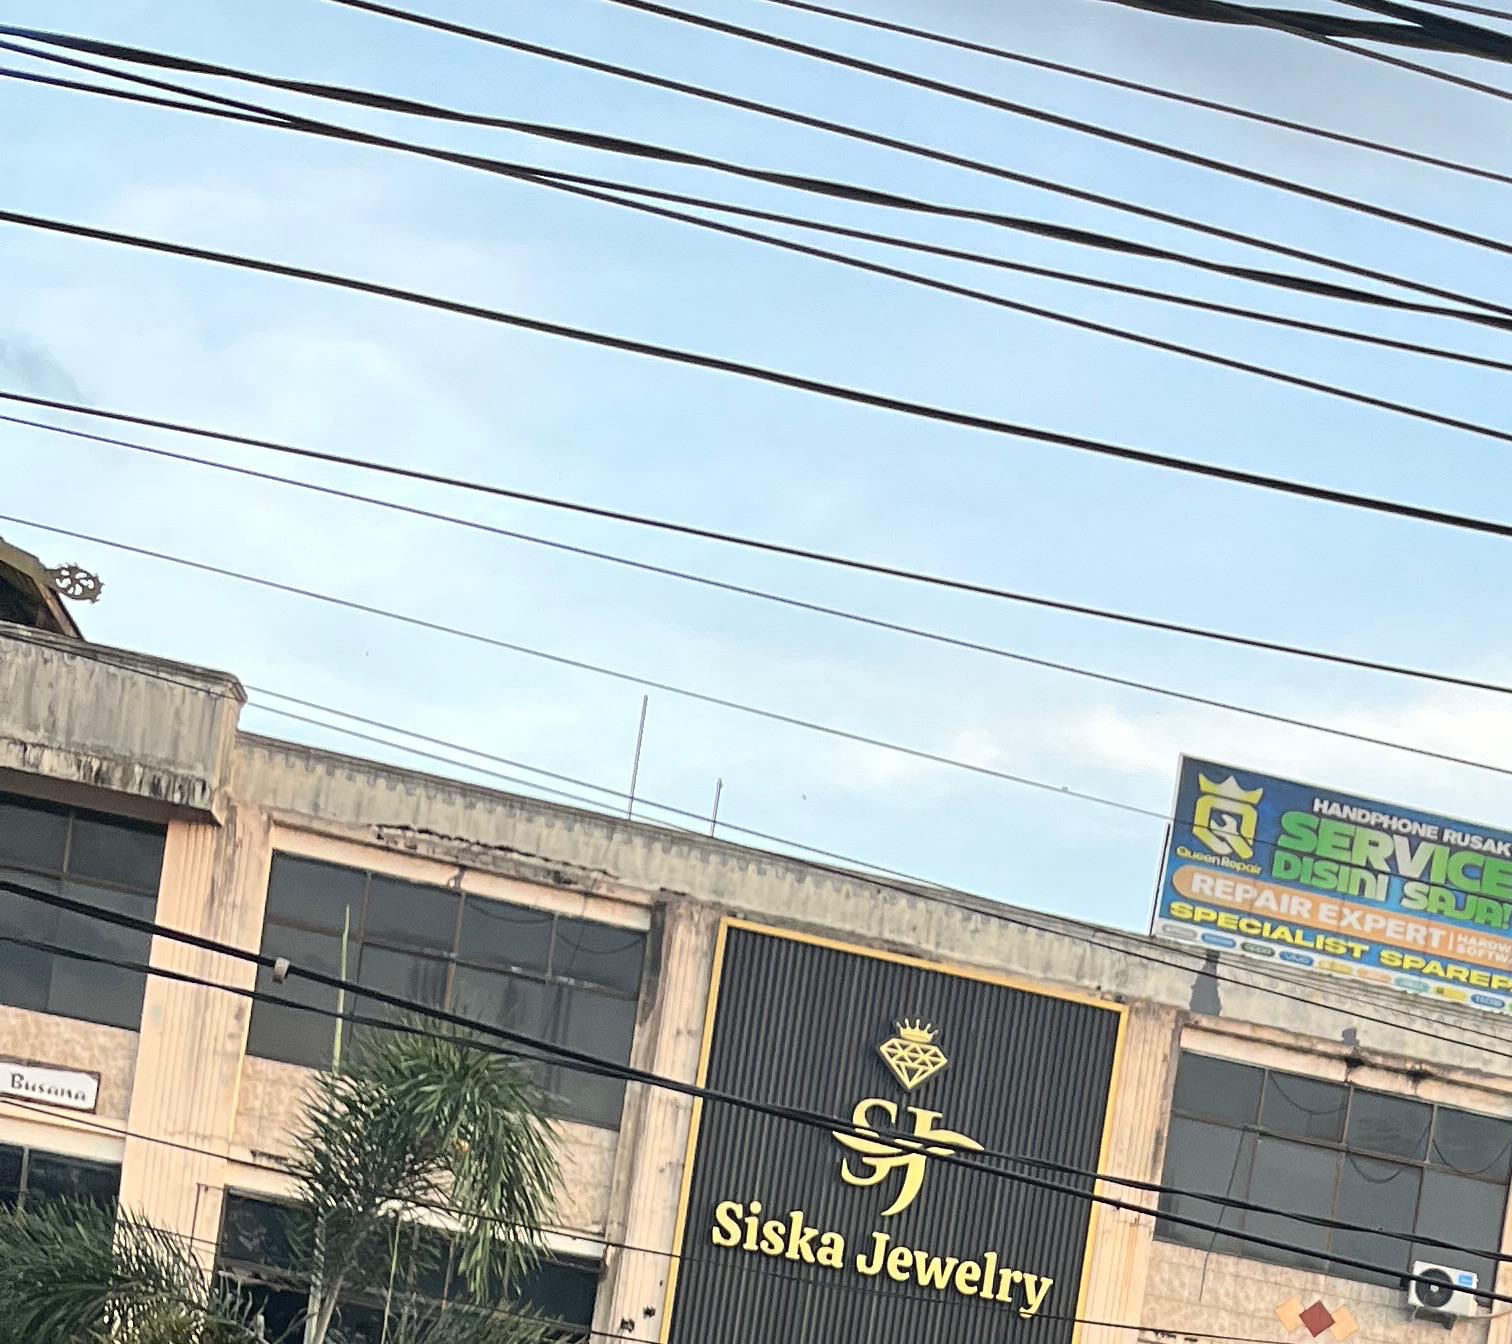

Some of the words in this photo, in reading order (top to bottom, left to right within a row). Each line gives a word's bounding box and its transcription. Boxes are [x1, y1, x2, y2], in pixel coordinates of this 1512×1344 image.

[1312, 798, 1439, 840] HANDPHONE
[1169, 901, 1369, 958] SPECIALIST
[1191, 872, 1312, 920] REPAIR
[1318, 901, 1448, 948] EXPERT
[1400, 880, 1512, 930] SAJA!
[712, 1201, 844, 1268] Siska
[857, 1231, 1053, 1319] Jewelry
